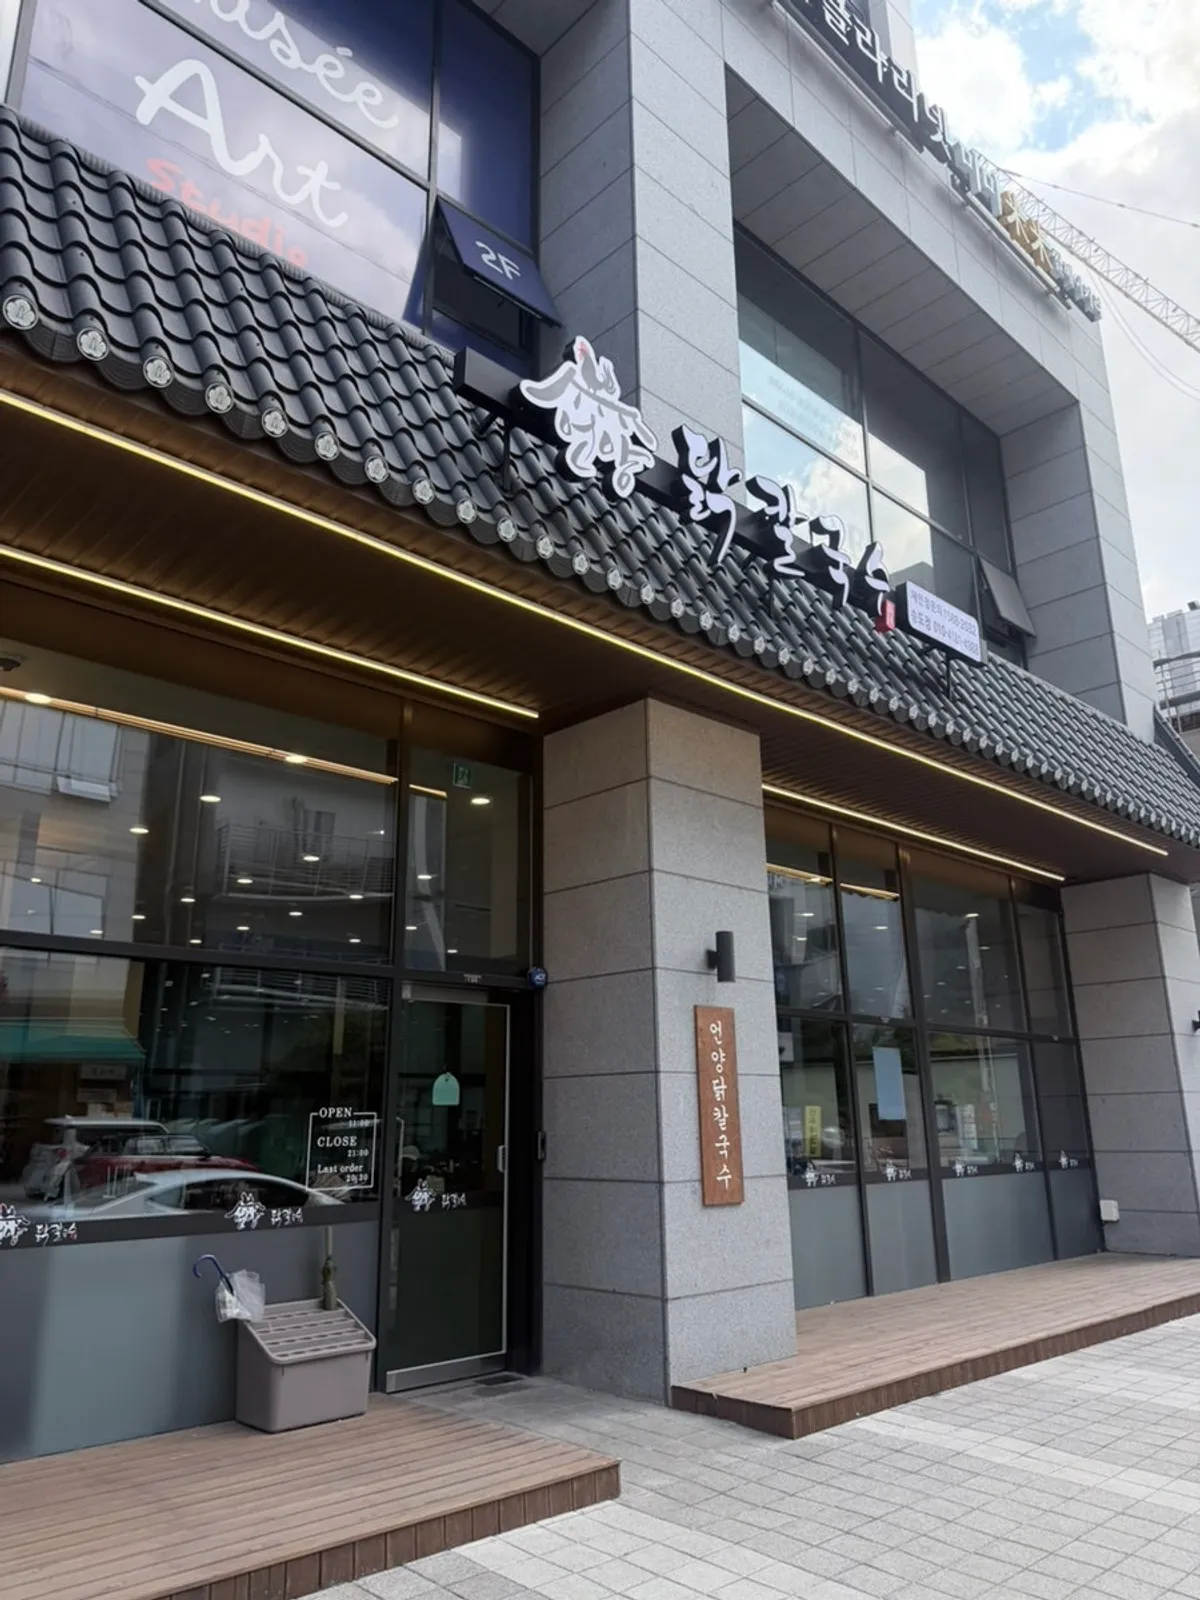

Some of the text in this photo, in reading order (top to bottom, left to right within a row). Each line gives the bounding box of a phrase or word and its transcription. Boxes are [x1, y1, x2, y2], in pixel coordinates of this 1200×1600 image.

[193, 0, 399, 129] usée
[134, 58, 348, 228] Art
[474, 240, 521, 280] 2F
[677, 424, 890, 616] 닭칼국수
[317, 1136, 358, 1148] CLOSE
[318, 1107, 353, 1118] OPEN
[709, 1020, 733, 1191] 언양닭칼국수
[317, 1162, 363, 1174] Last order
